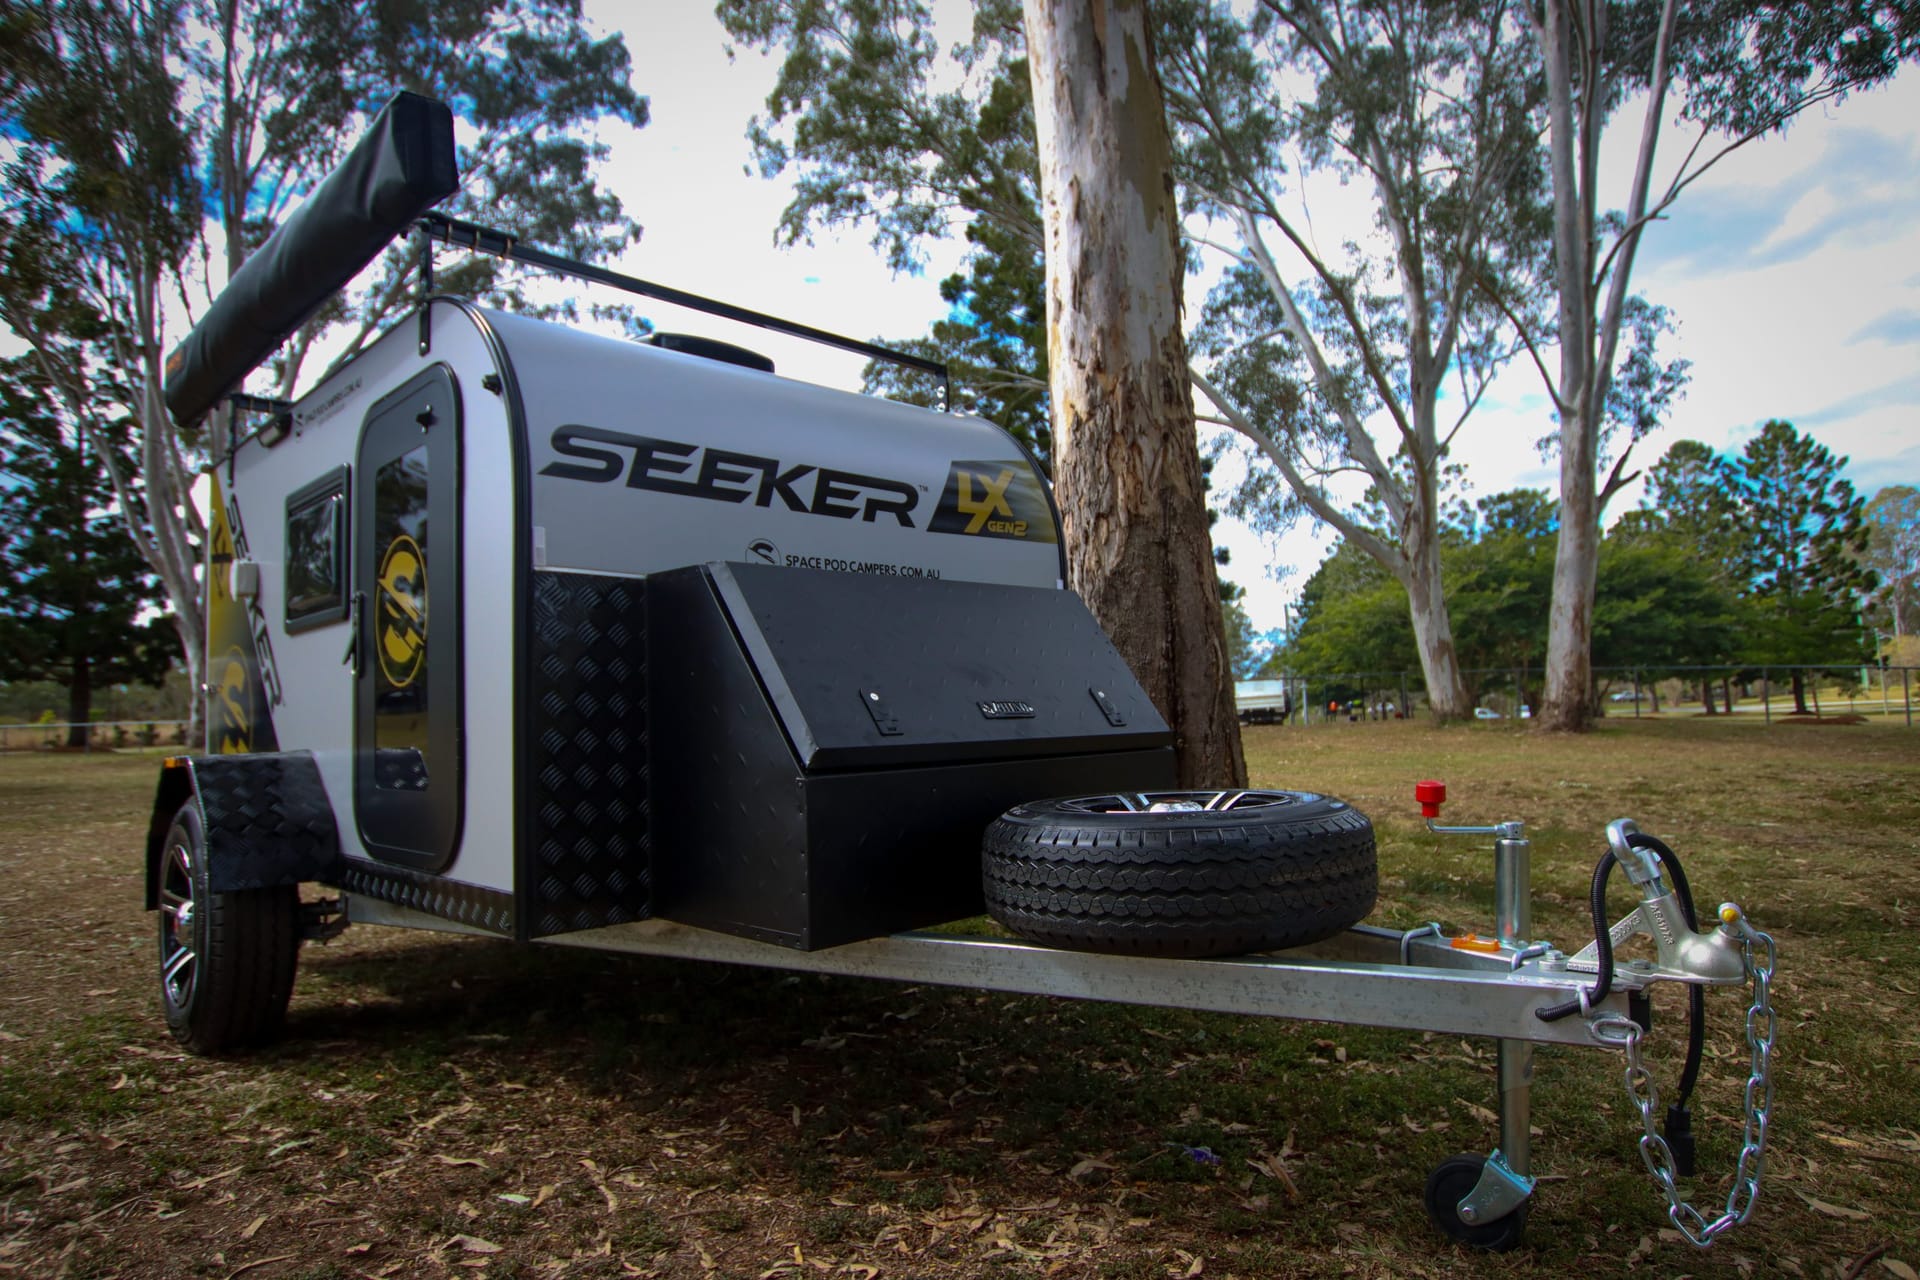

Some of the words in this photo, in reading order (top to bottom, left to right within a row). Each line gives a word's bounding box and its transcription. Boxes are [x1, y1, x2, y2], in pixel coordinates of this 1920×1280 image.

[538, 424, 919, 528] SEEKER
[987, 520, 1028, 537] GEN2
[785, 555, 821, 569] SPACE
[825, 559, 848, 571] POD
[850, 561, 940, 580] CAMPERS.COM.AU
